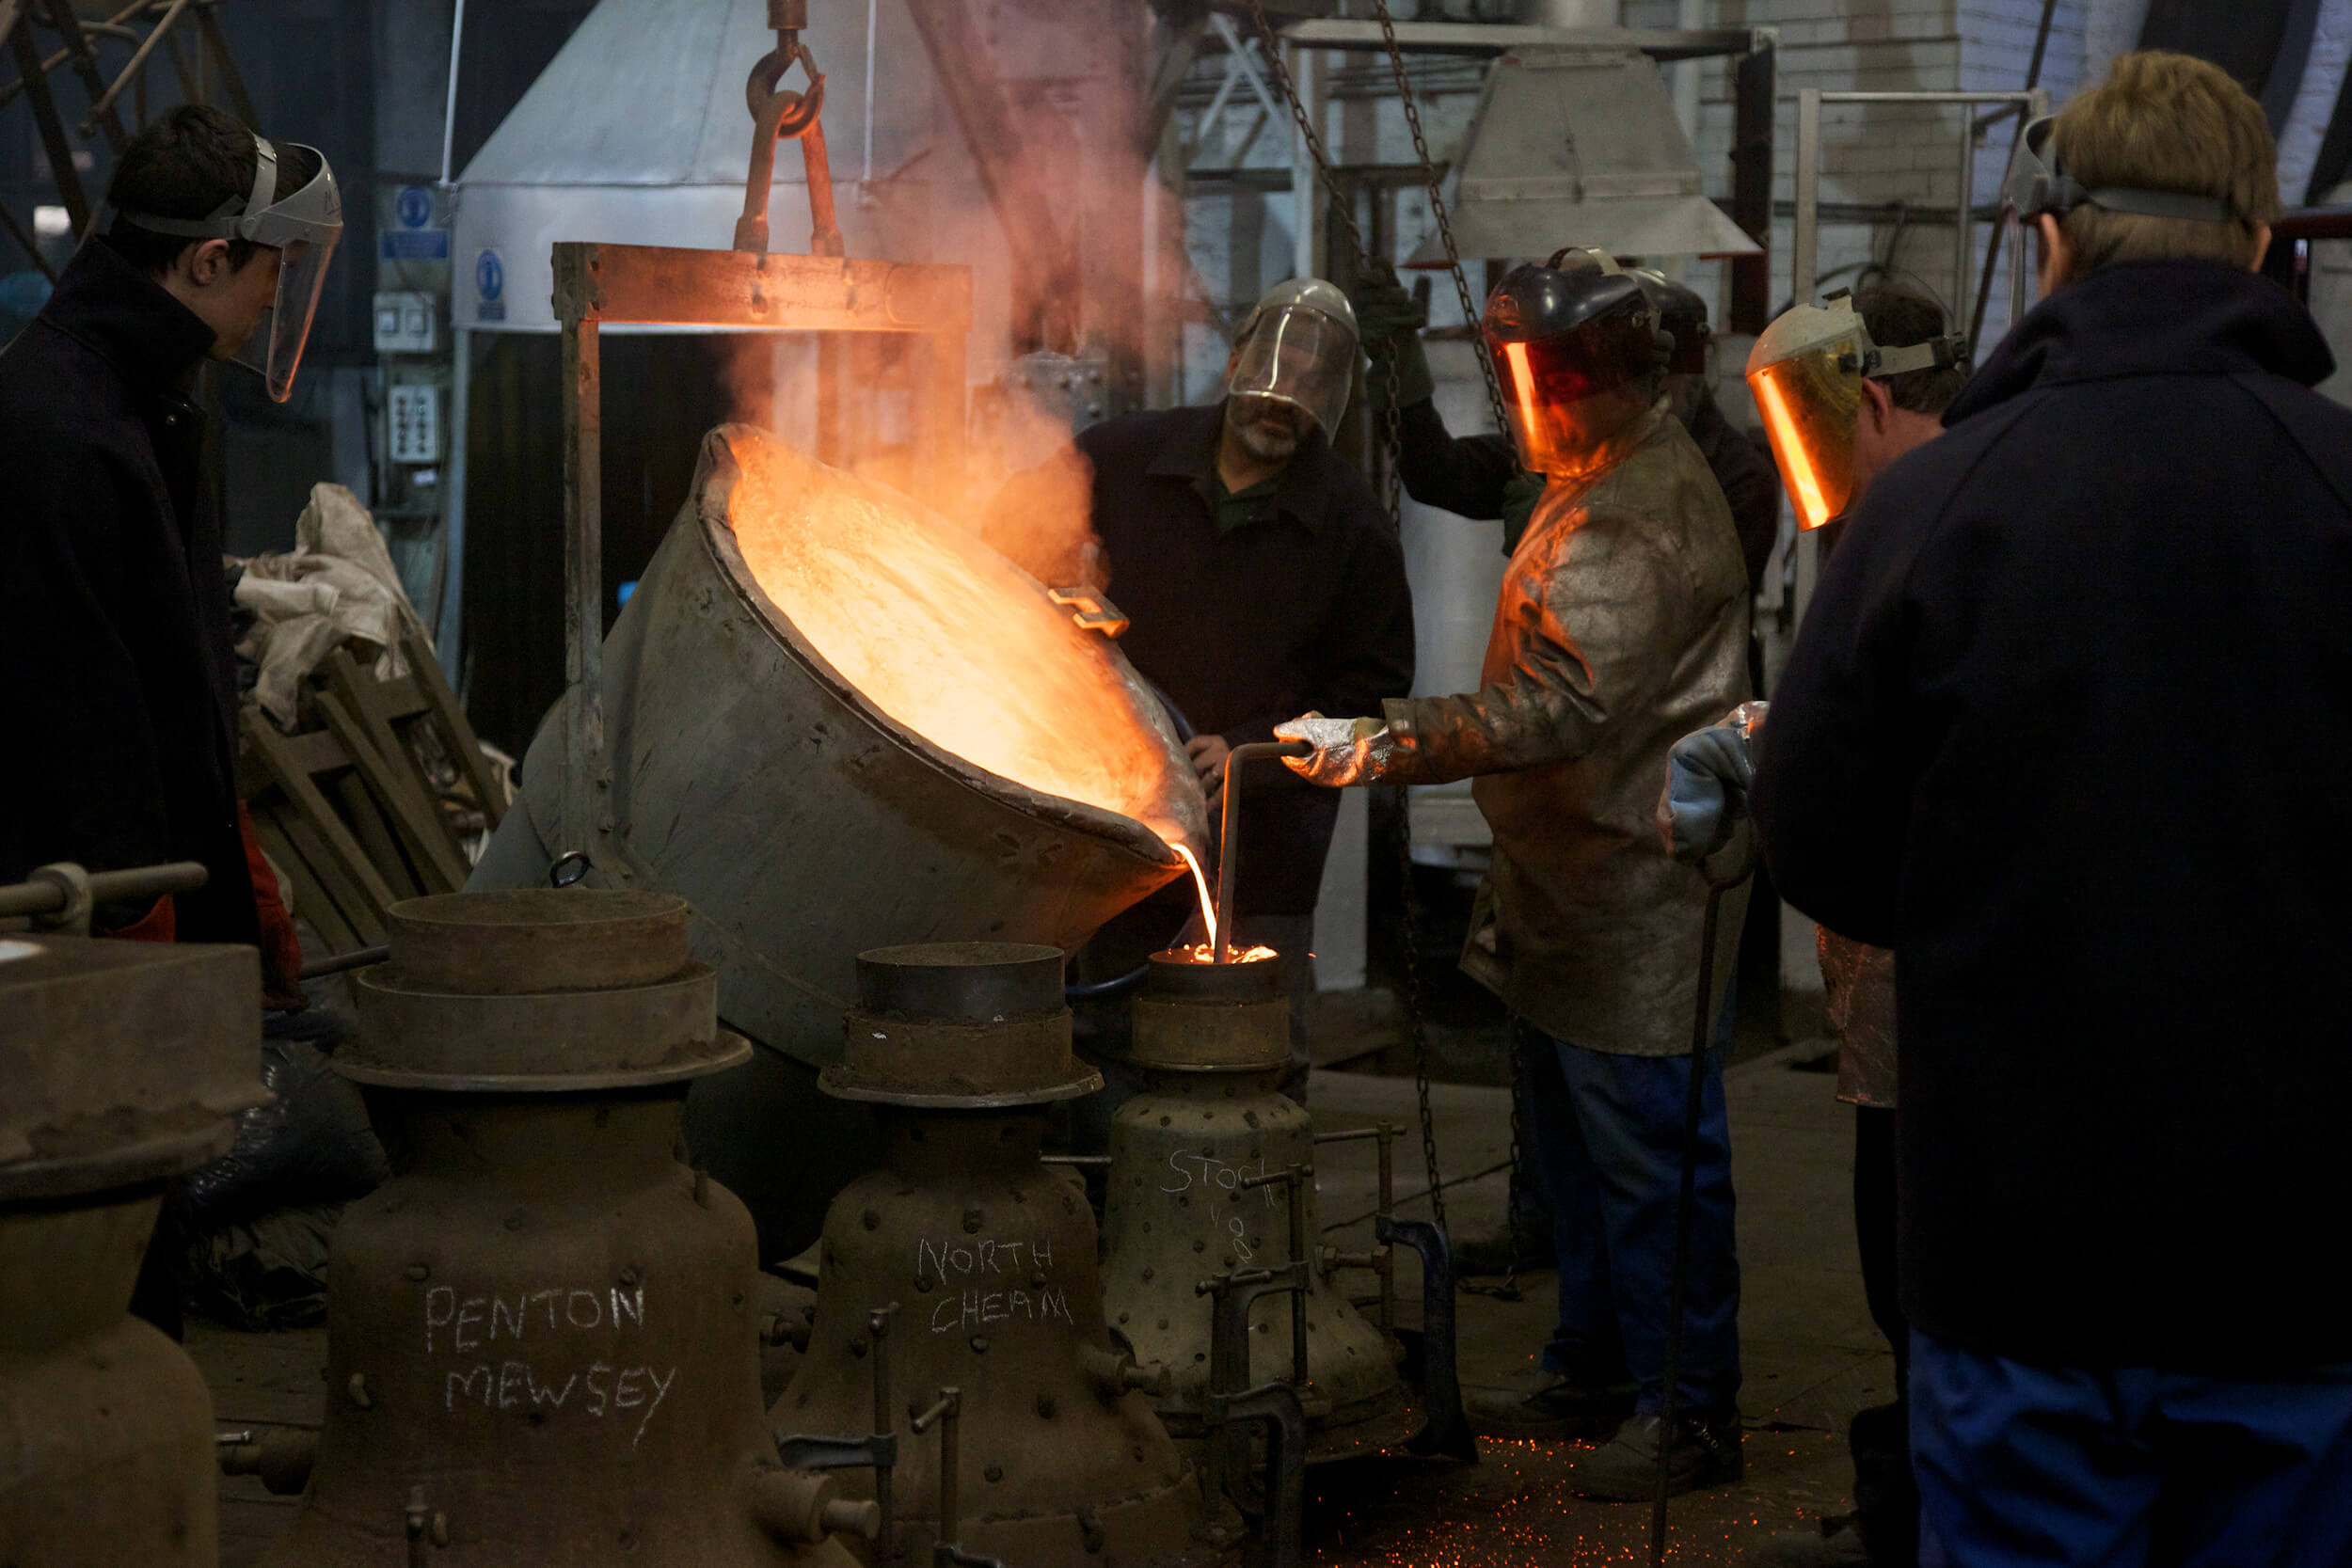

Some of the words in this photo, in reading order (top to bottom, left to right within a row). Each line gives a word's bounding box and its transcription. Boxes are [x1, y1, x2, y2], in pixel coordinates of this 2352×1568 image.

[918, 1237, 1054, 1286] NORTH
[426, 1286, 644, 1354] PENTON
[931, 1288, 1074, 1333] CHEAM
[445, 1362, 676, 1452] MEWSEY
